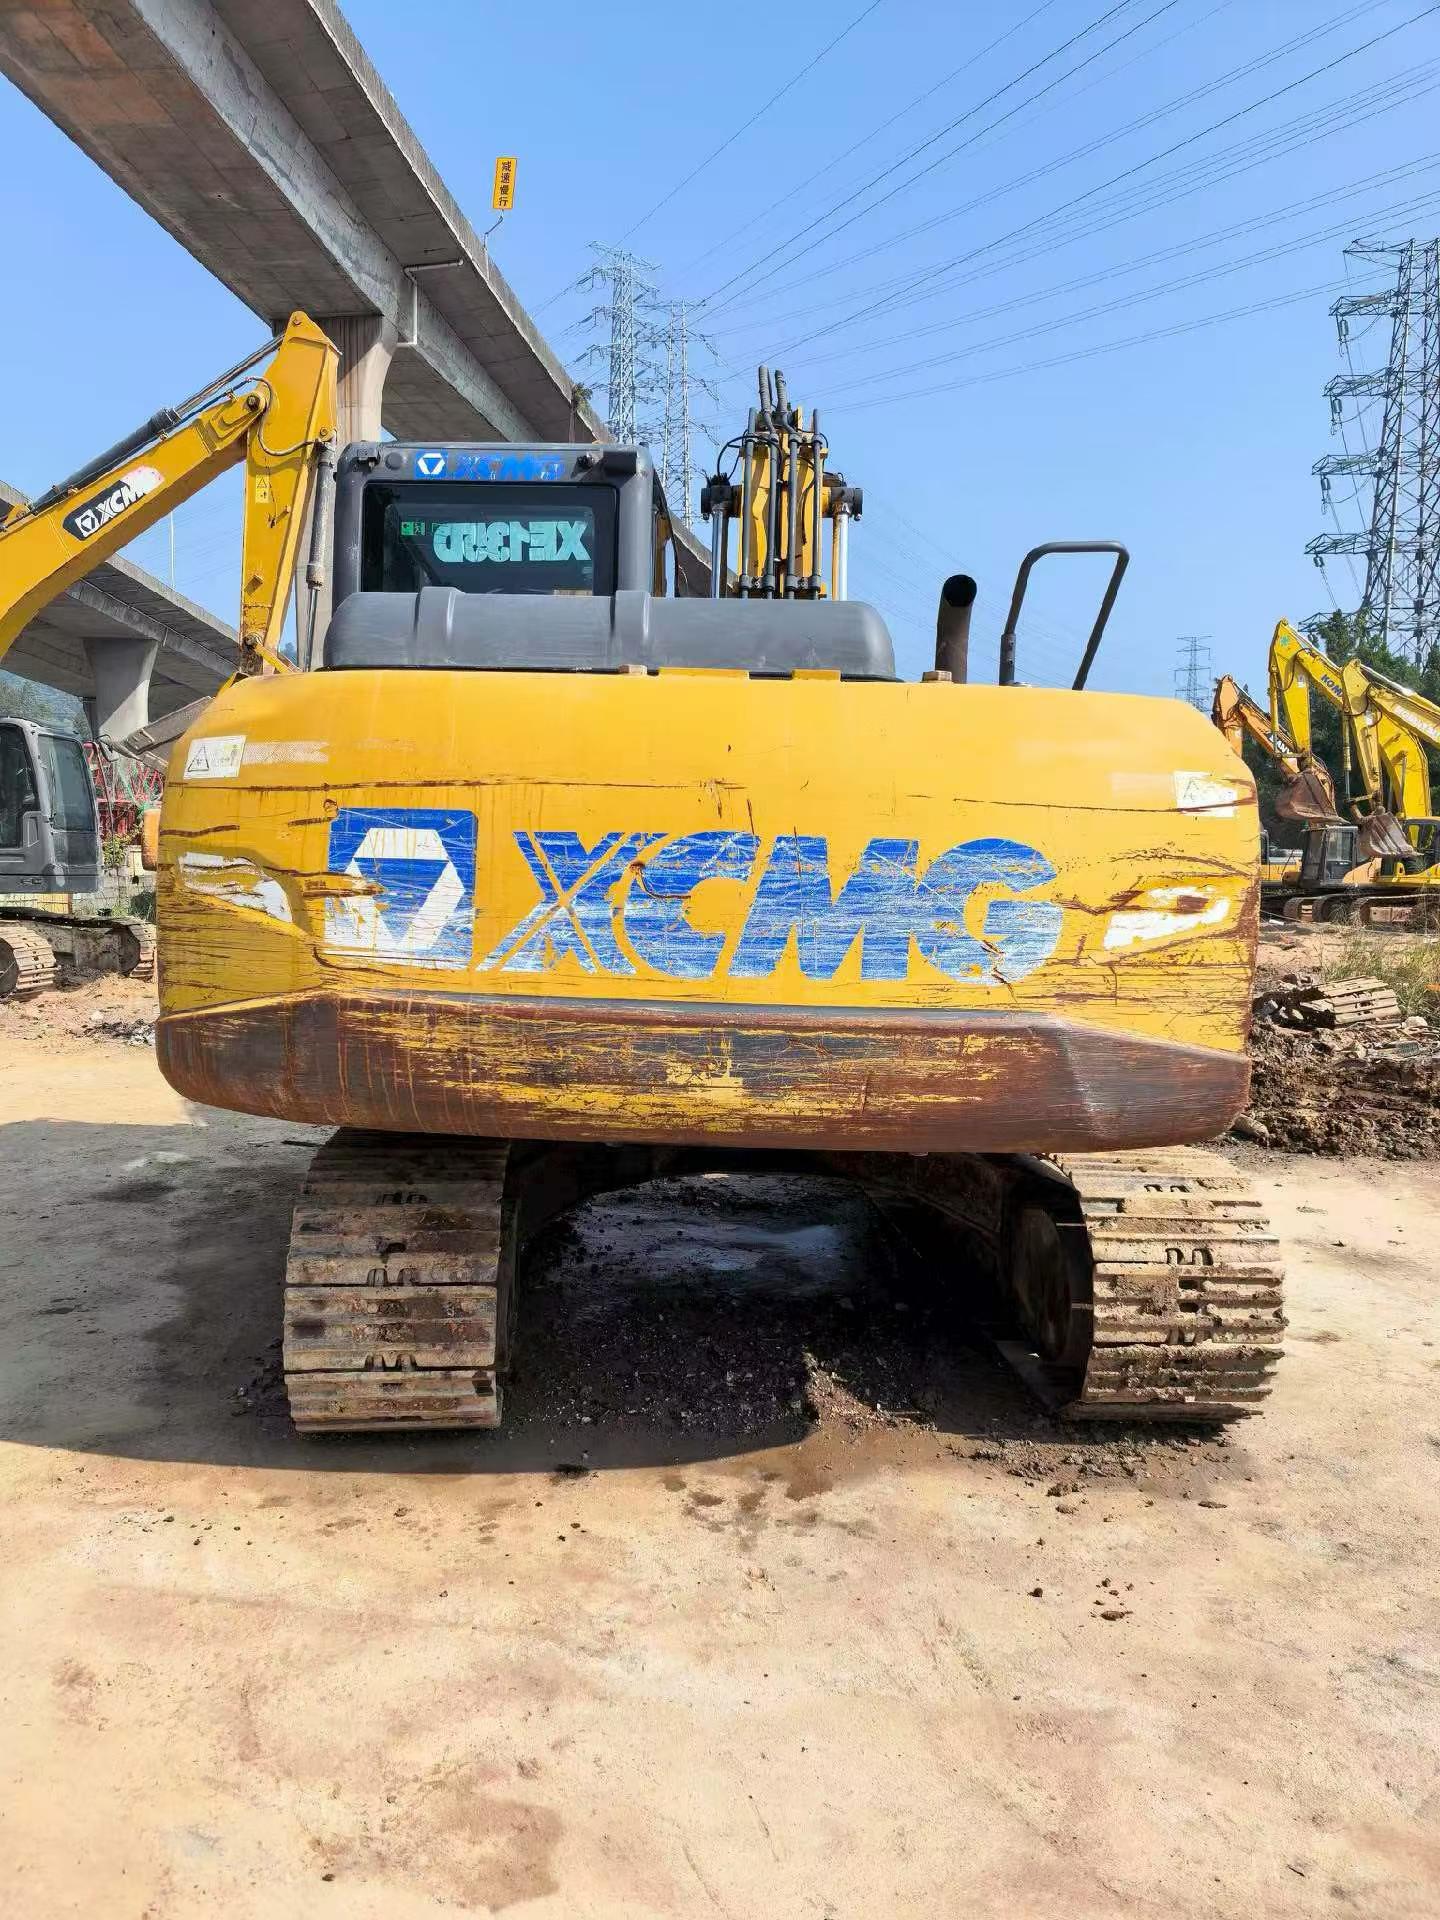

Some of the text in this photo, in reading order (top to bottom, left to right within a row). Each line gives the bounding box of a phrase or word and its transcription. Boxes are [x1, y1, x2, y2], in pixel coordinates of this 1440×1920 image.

[498, 160, 511, 206] 减速慢行
[477, 830, 1065, 985] XCMG
